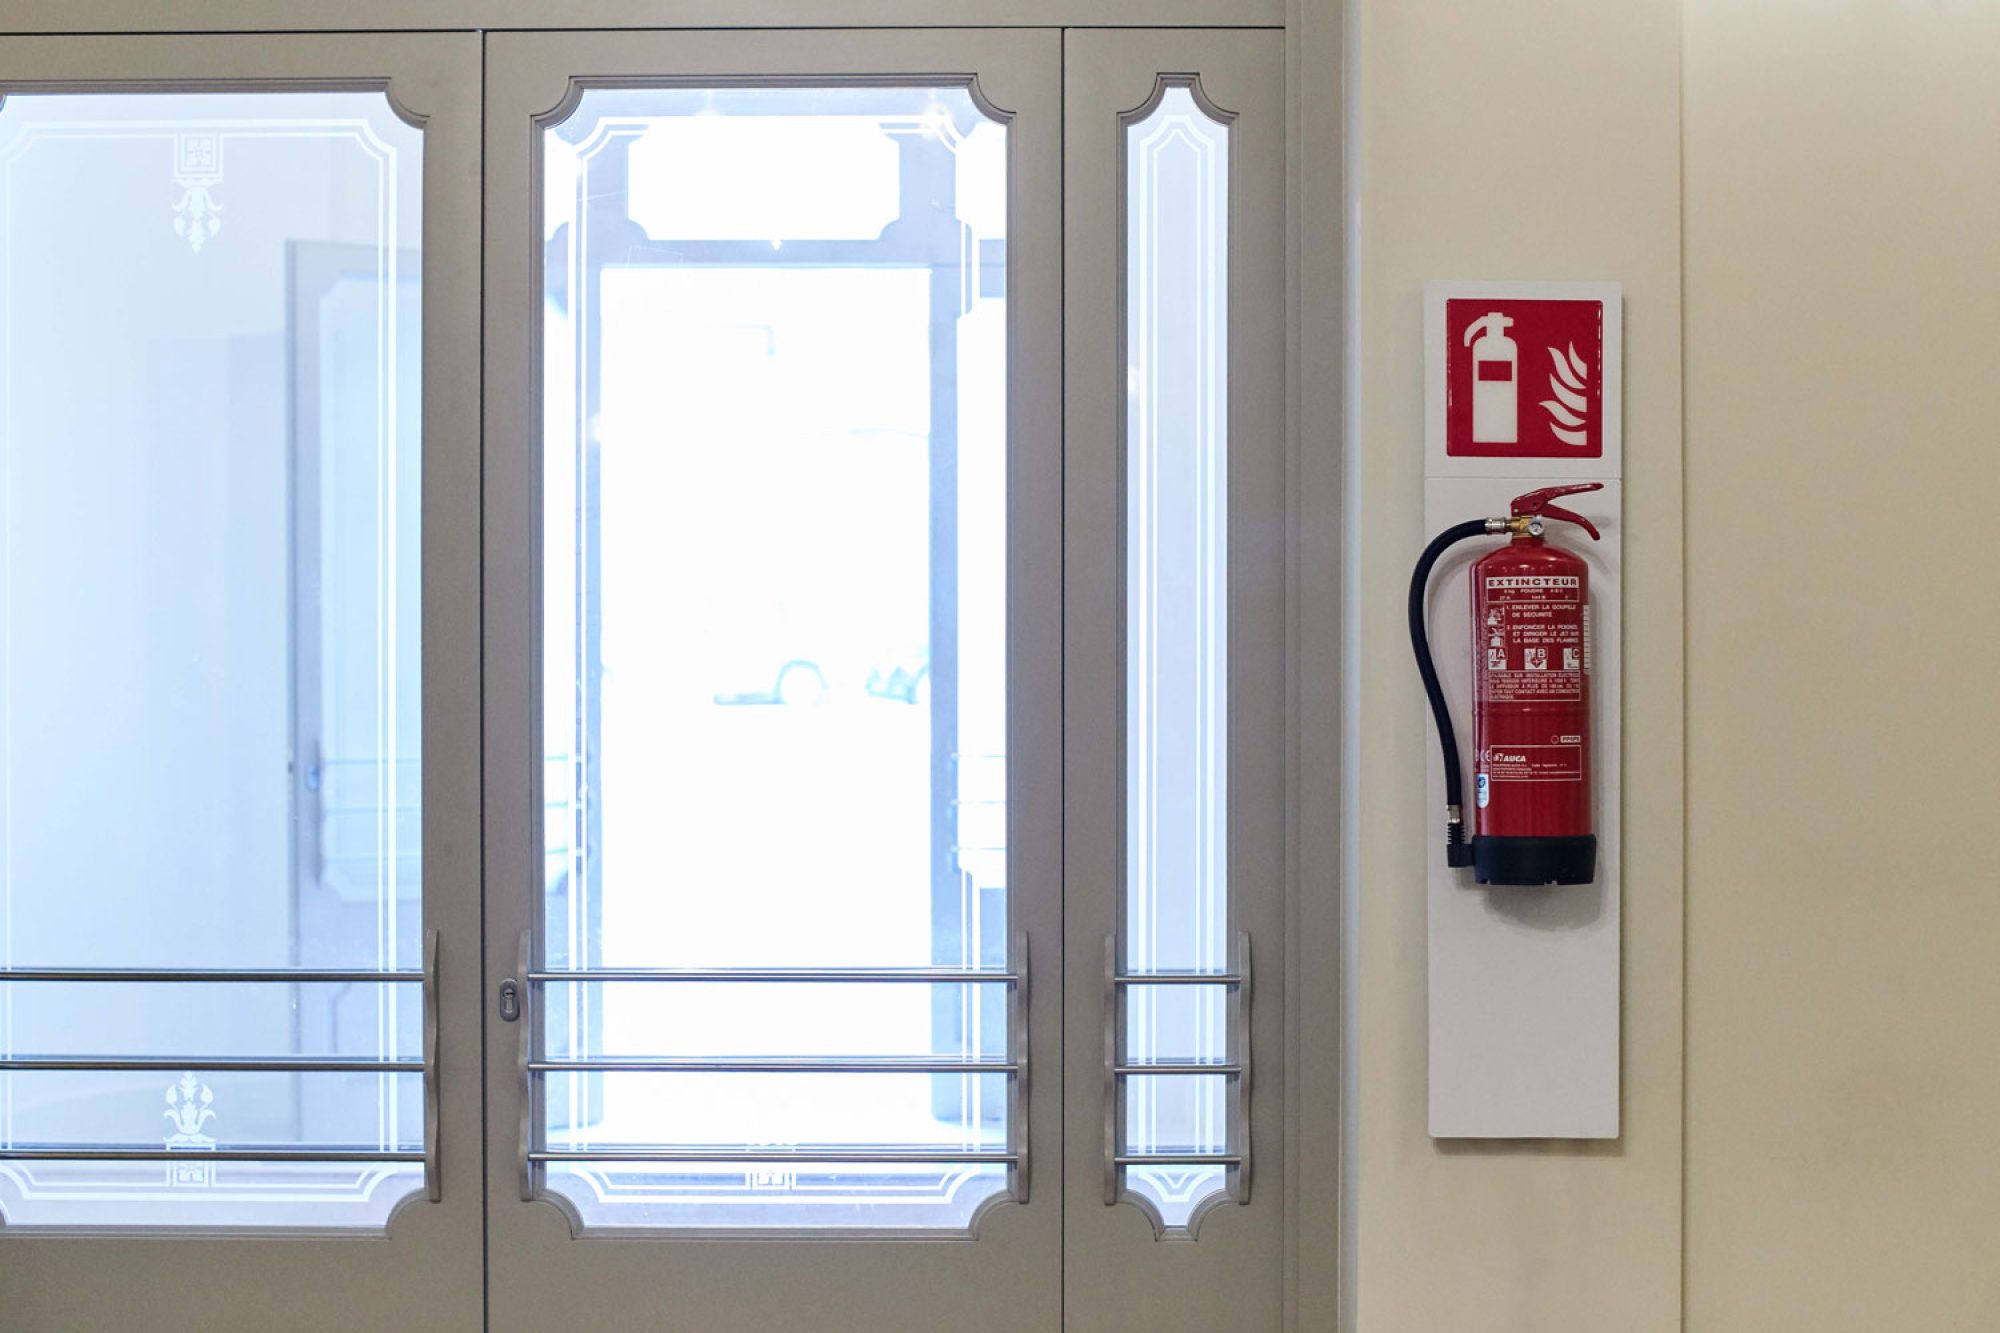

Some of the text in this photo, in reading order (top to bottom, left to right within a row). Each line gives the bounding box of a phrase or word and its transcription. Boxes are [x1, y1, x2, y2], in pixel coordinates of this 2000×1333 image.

[1488, 578, 1577, 587] EXTINCTEUR
[1497, 648, 1506, 658] A
[1537, 648, 1546, 658] B
[1572, 648, 1580, 658] C
